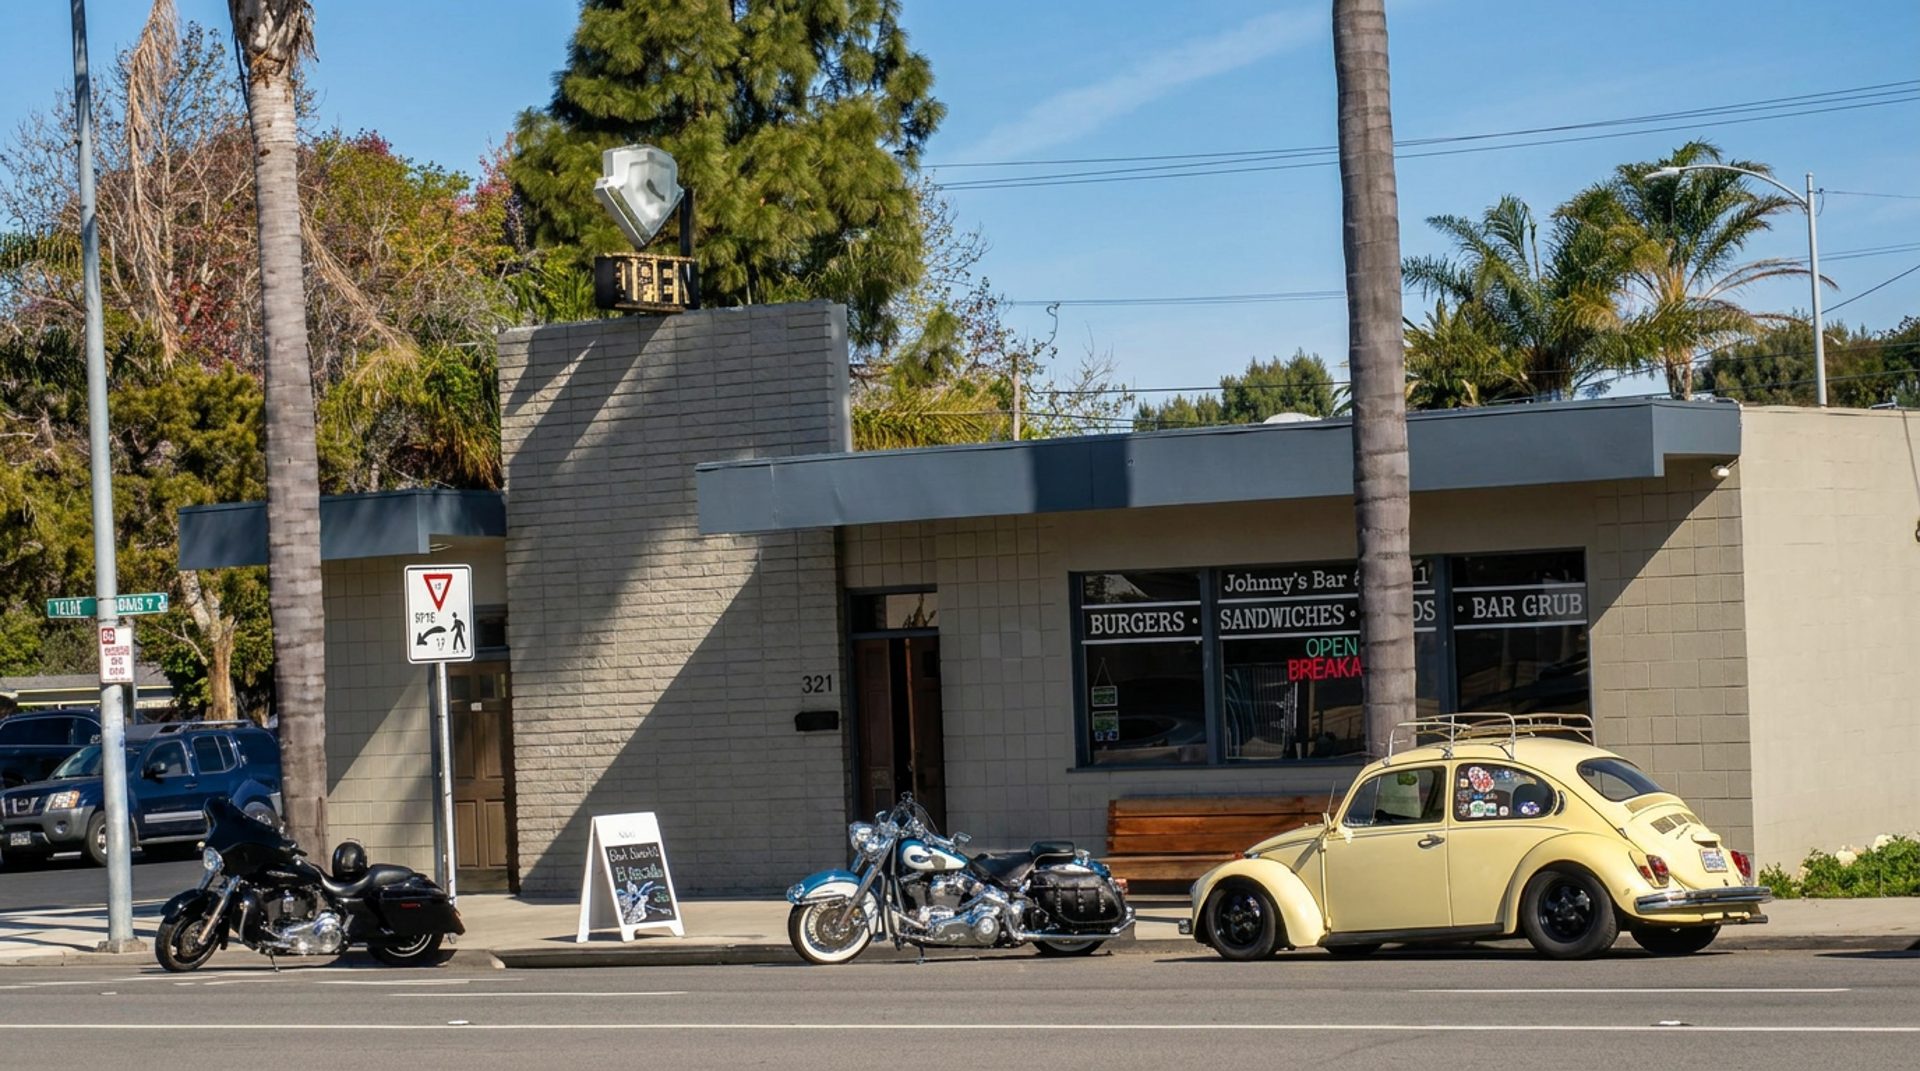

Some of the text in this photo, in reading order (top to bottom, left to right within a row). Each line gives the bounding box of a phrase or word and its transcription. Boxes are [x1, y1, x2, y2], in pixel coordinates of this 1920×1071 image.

[1224, 572, 1308, 595] Johnny's
[1312, 570, 1347, 589] Bar
[1220, 604, 1345, 630] SANDWICHES
[1472, 593, 1583, 619] BAR GRUB
[1090, 611, 1185, 635] BURGERS
[1306, 637, 1358, 658] OPEN
[802, 674, 832, 694] 321
